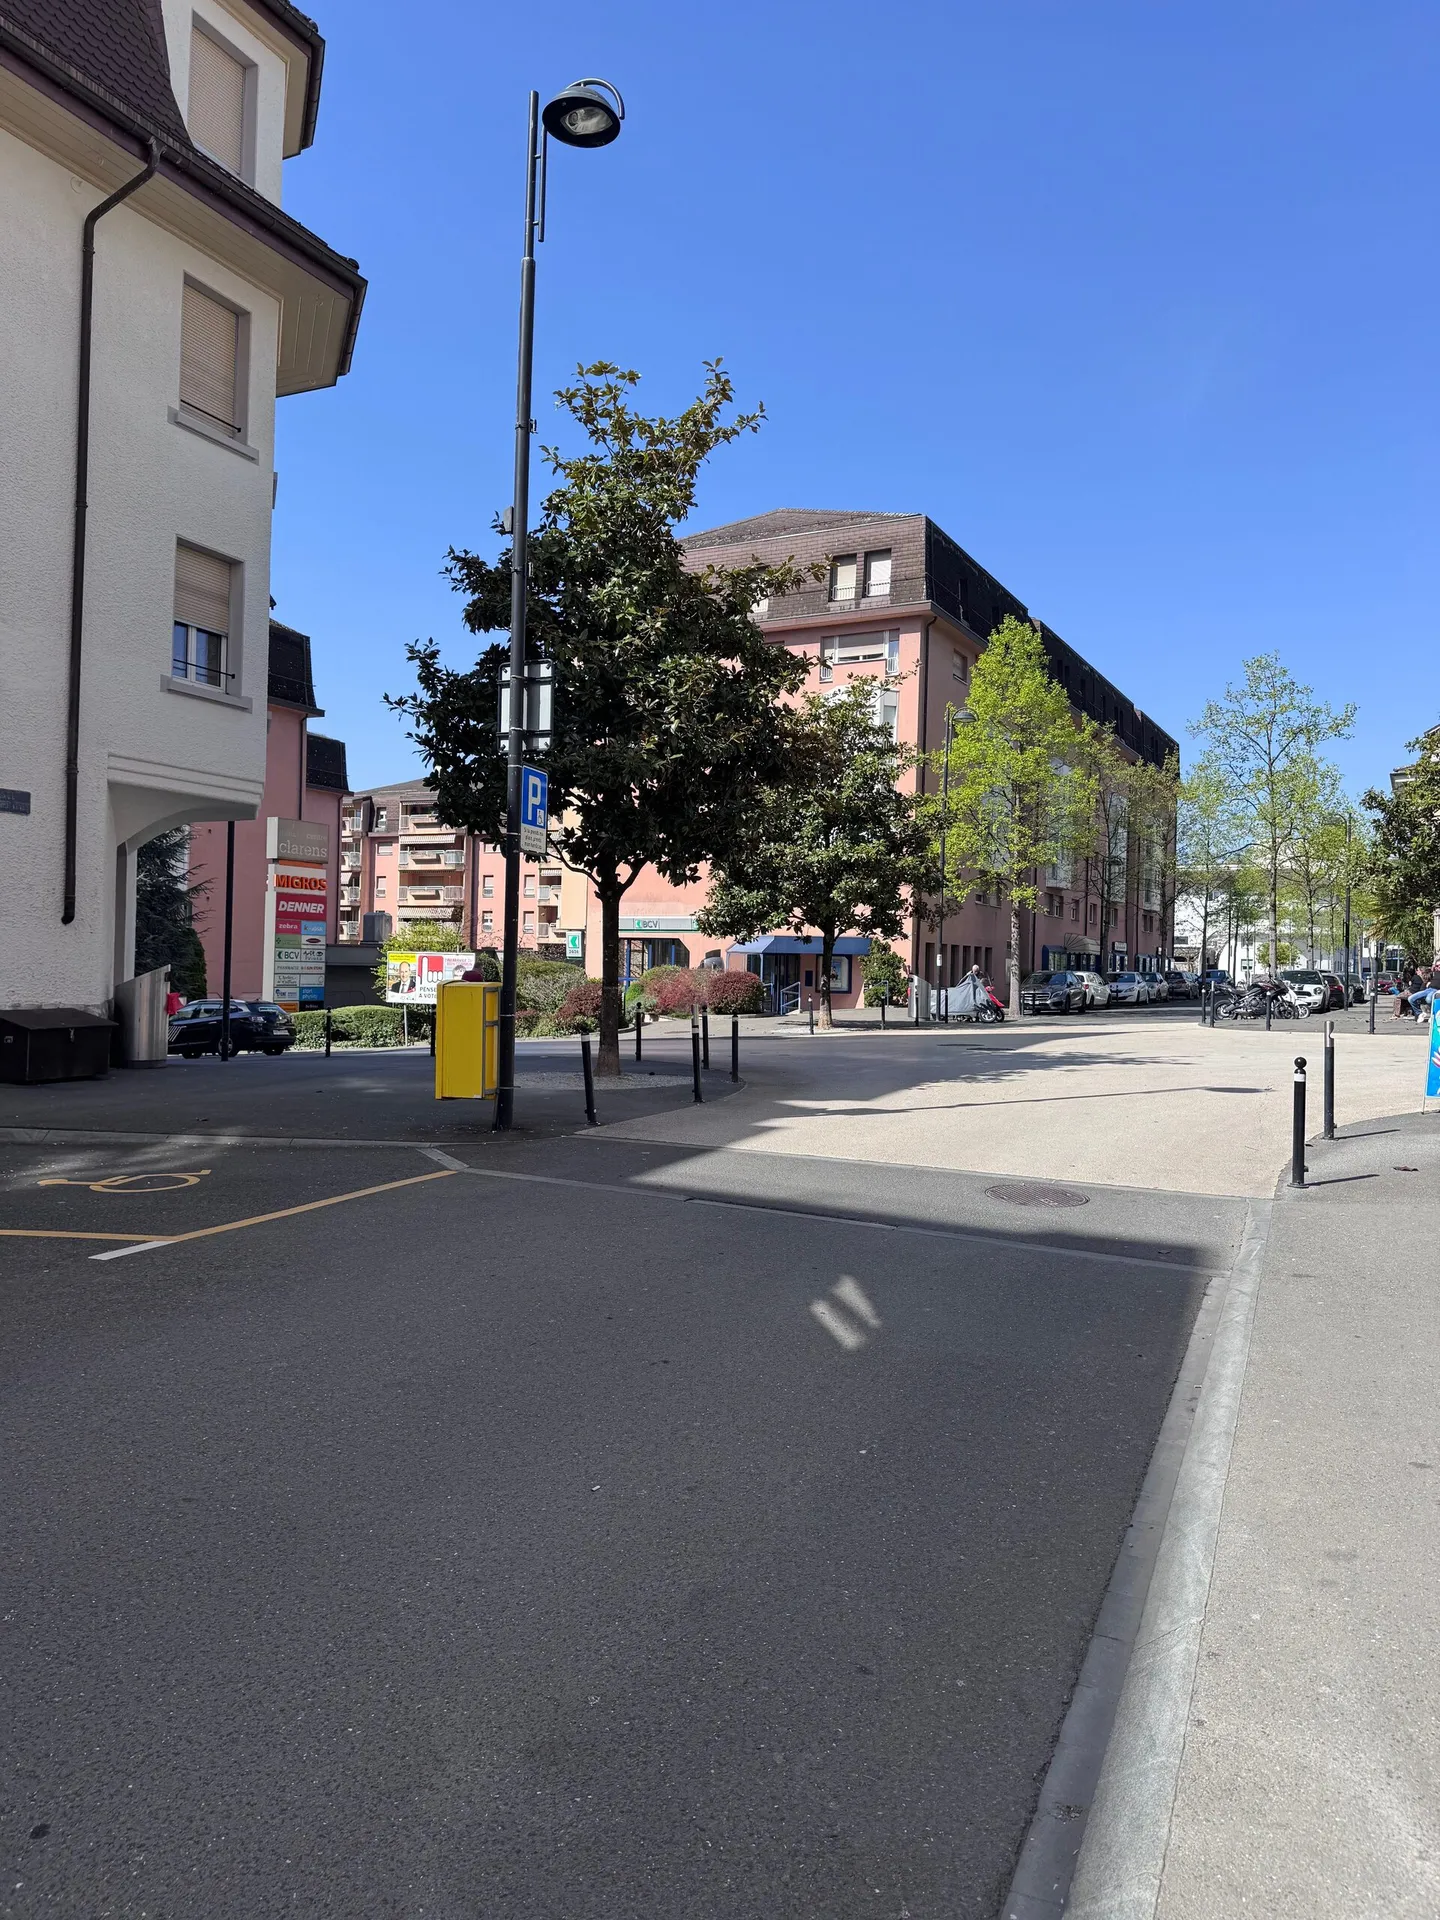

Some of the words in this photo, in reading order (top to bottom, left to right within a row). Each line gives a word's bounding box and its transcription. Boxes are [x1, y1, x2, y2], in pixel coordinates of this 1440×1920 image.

[528, 775, 541, 820] P
[280, 840, 328, 857] clarens
[275, 874, 328, 891] MIGROS
[278, 901, 324, 914] DENNER
[285, 951, 299, 960] BCV
